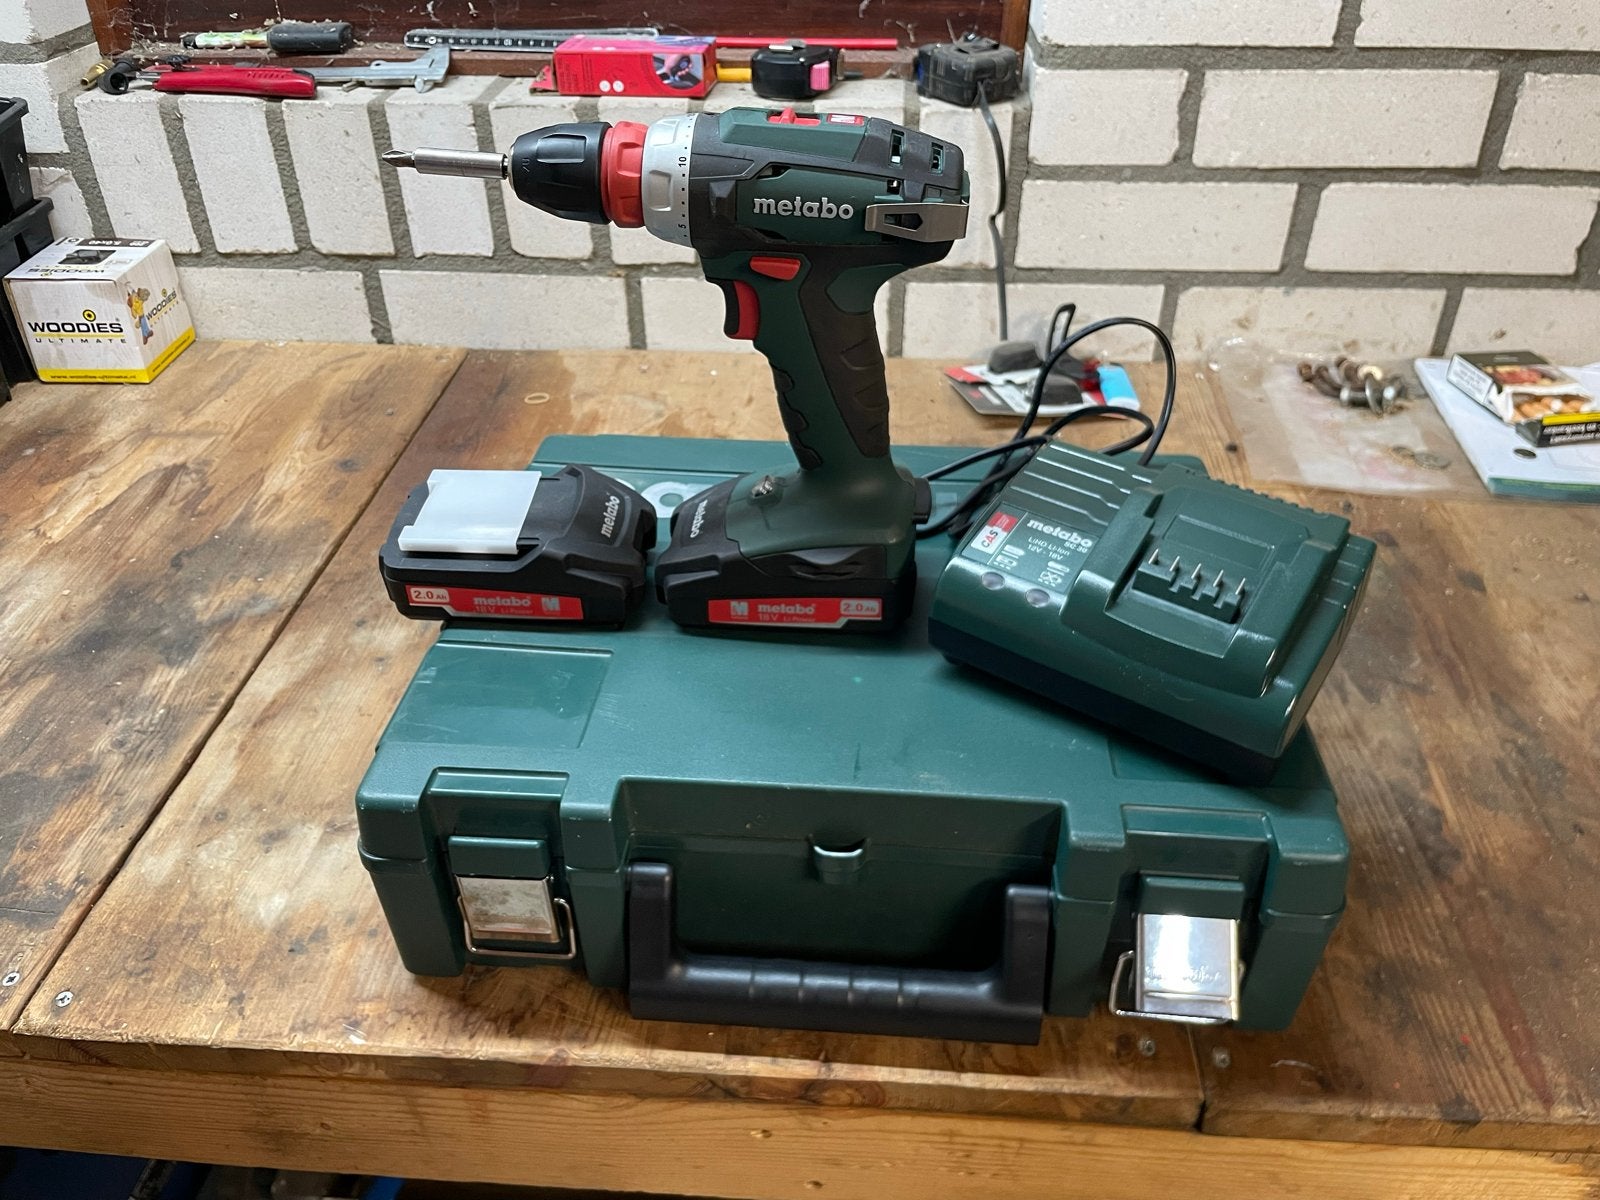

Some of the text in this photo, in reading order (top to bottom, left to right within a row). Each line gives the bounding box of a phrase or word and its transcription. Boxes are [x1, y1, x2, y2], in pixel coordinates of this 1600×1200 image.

[678, 156, 687, 168] 10
[753, 197, 854, 220] metabo
[145, 290, 177, 320] WOODIES
[28, 322, 124, 333] WOODIES
[600, 495, 620, 538] metabo
[690, 498, 708, 539] metabo
[981, 529, 998, 548] CAS
[1027, 519, 1093, 548] metabo
[1028, 544, 1042, 554] 12V
[1048, 551, 1063, 560] 18V
[1076, 545, 1088, 554] 30
[413, 590, 434, 600] 2.0
[473, 596, 531, 606] metabo
[757, 603, 815, 614] metabo
[843, 603, 863, 611] 2.0
